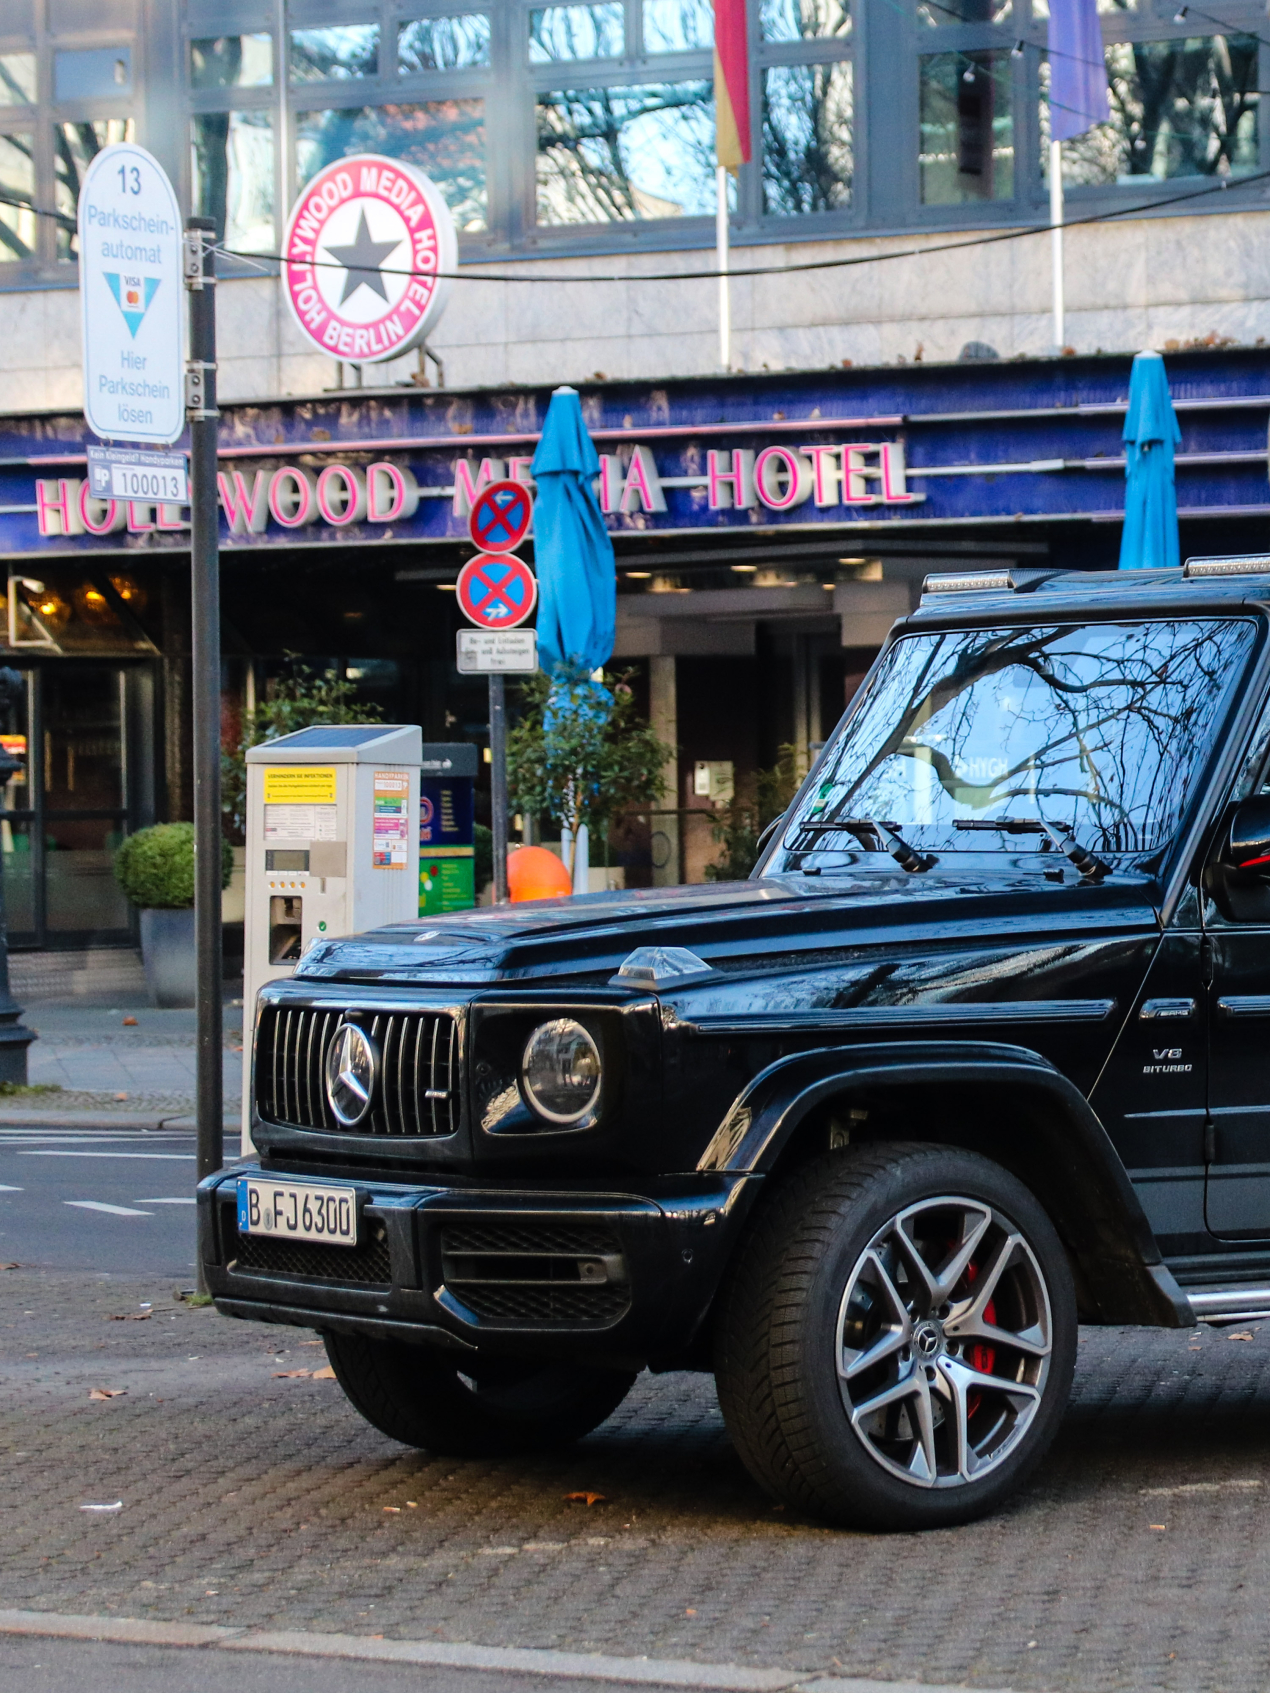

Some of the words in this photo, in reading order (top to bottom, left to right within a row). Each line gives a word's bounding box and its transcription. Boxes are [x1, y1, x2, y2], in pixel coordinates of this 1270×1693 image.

[117, 164, 142, 196] 13
[87, 204, 175, 236] Parkschein-
[101, 240, 162, 264] automat
[290, 171, 354, 330] HOLLYWOOD
[359, 166, 425, 228] MEDIA
[400, 228, 437, 316] HOTEL
[123, 275, 141, 287] VISA
[322, 313, 405, 354] BERLIN
[120, 350, 147, 370] Hier
[99, 374, 170, 399] Parkschein
[118, 403, 153, 424] lösen
[36, 462, 406, 536] HOLLWOOD
[453, 444, 655, 516] MIA
[707, 442, 917, 512] HOTEL
[121, 472, 179, 497] 100013
[1152, 1048, 1182, 1060] V8
[1142, 1064, 1193, 1074] BITURBO
